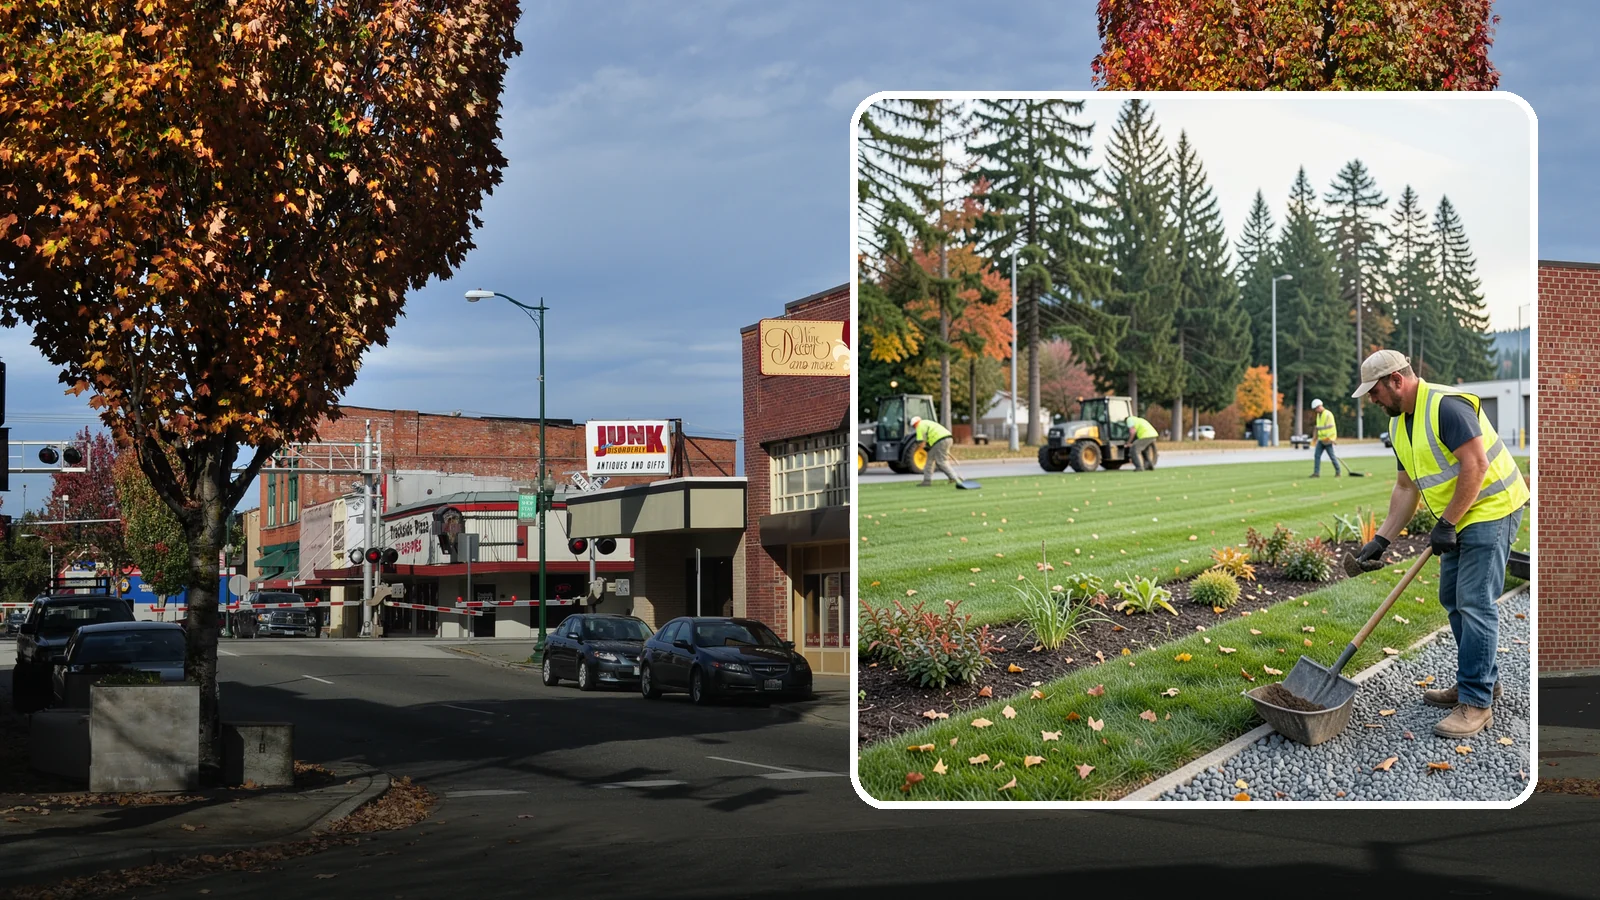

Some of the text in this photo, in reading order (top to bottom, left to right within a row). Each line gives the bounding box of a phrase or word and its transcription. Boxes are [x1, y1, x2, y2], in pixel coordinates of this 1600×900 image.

[595, 425, 665, 457] JUNK
[607, 446, 646, 454] DISORDERLY
[597, 460, 665, 470] ANTIQUES AND GIFTS
[390, 519, 429, 540] Trackside Pizza
